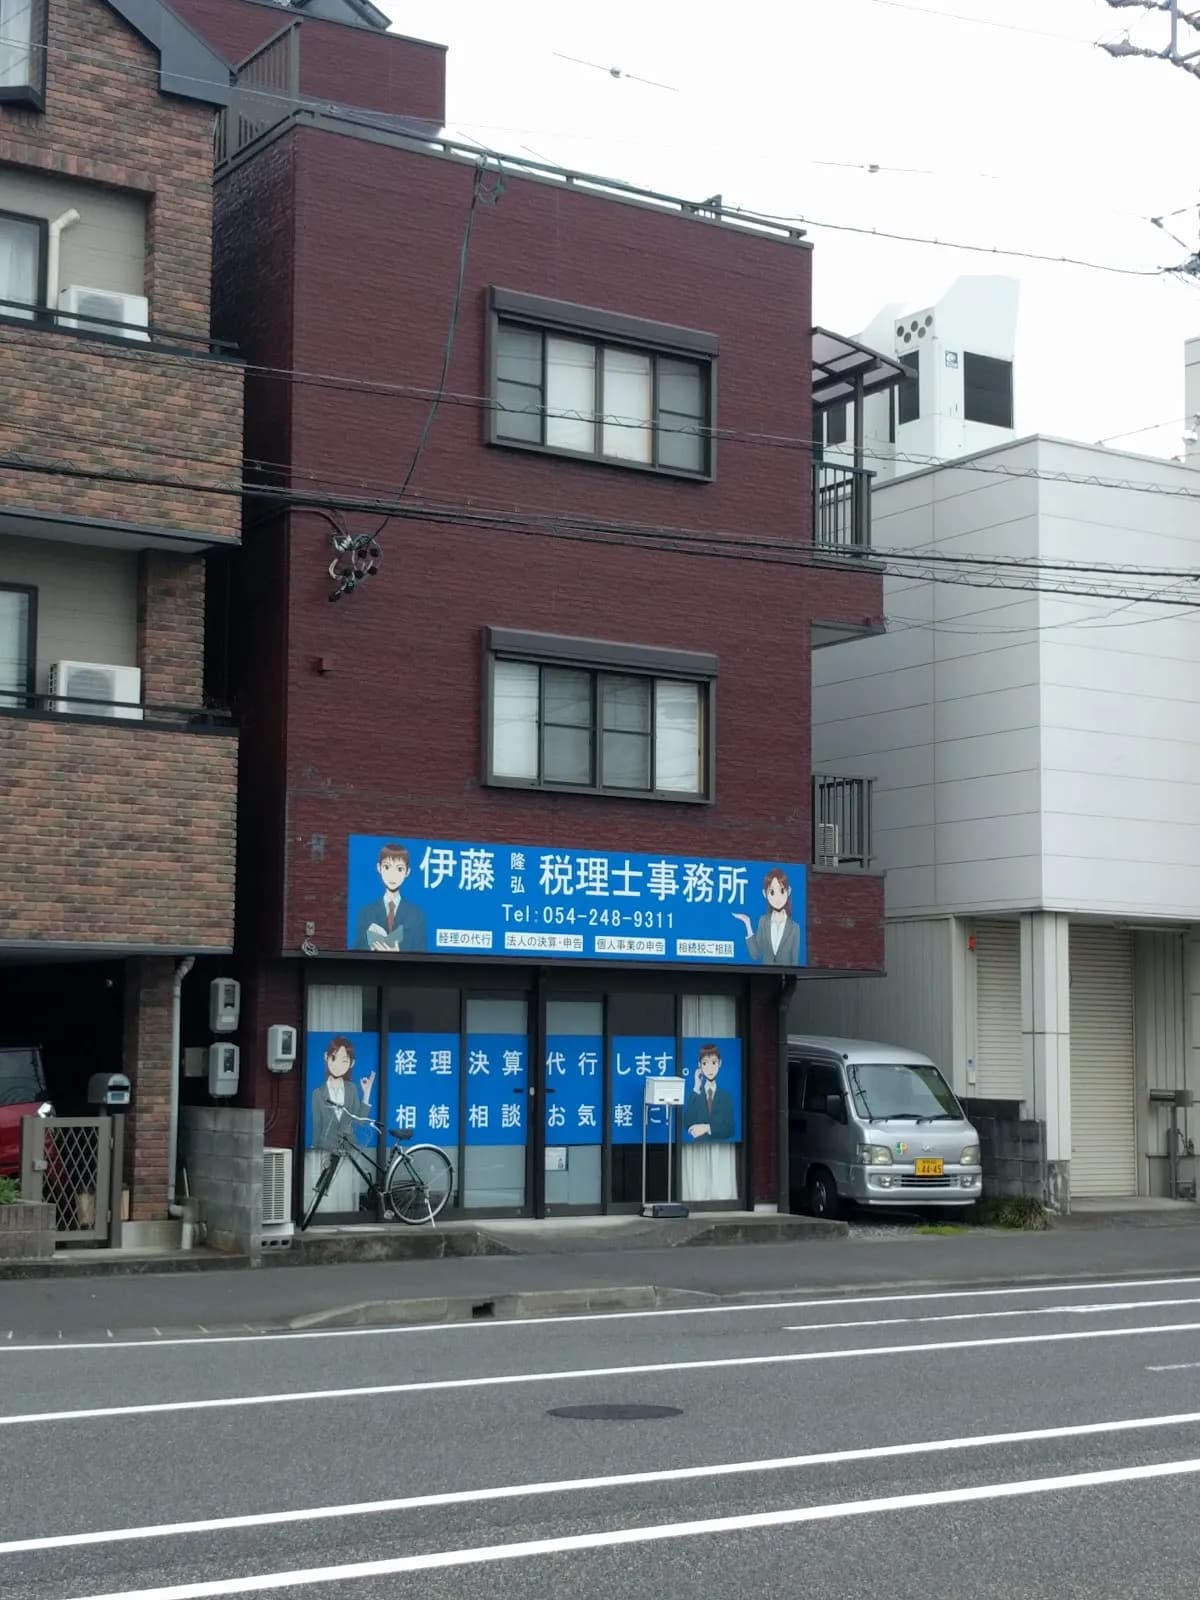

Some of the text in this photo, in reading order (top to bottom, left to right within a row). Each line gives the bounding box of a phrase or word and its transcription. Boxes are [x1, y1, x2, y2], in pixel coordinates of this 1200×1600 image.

[419, 846, 749, 905] 伊藤 隆弘 税理士事務所
[438, 931, 491, 946] 経理の代行
[596, 939, 664, 952] 個人事業の申告
